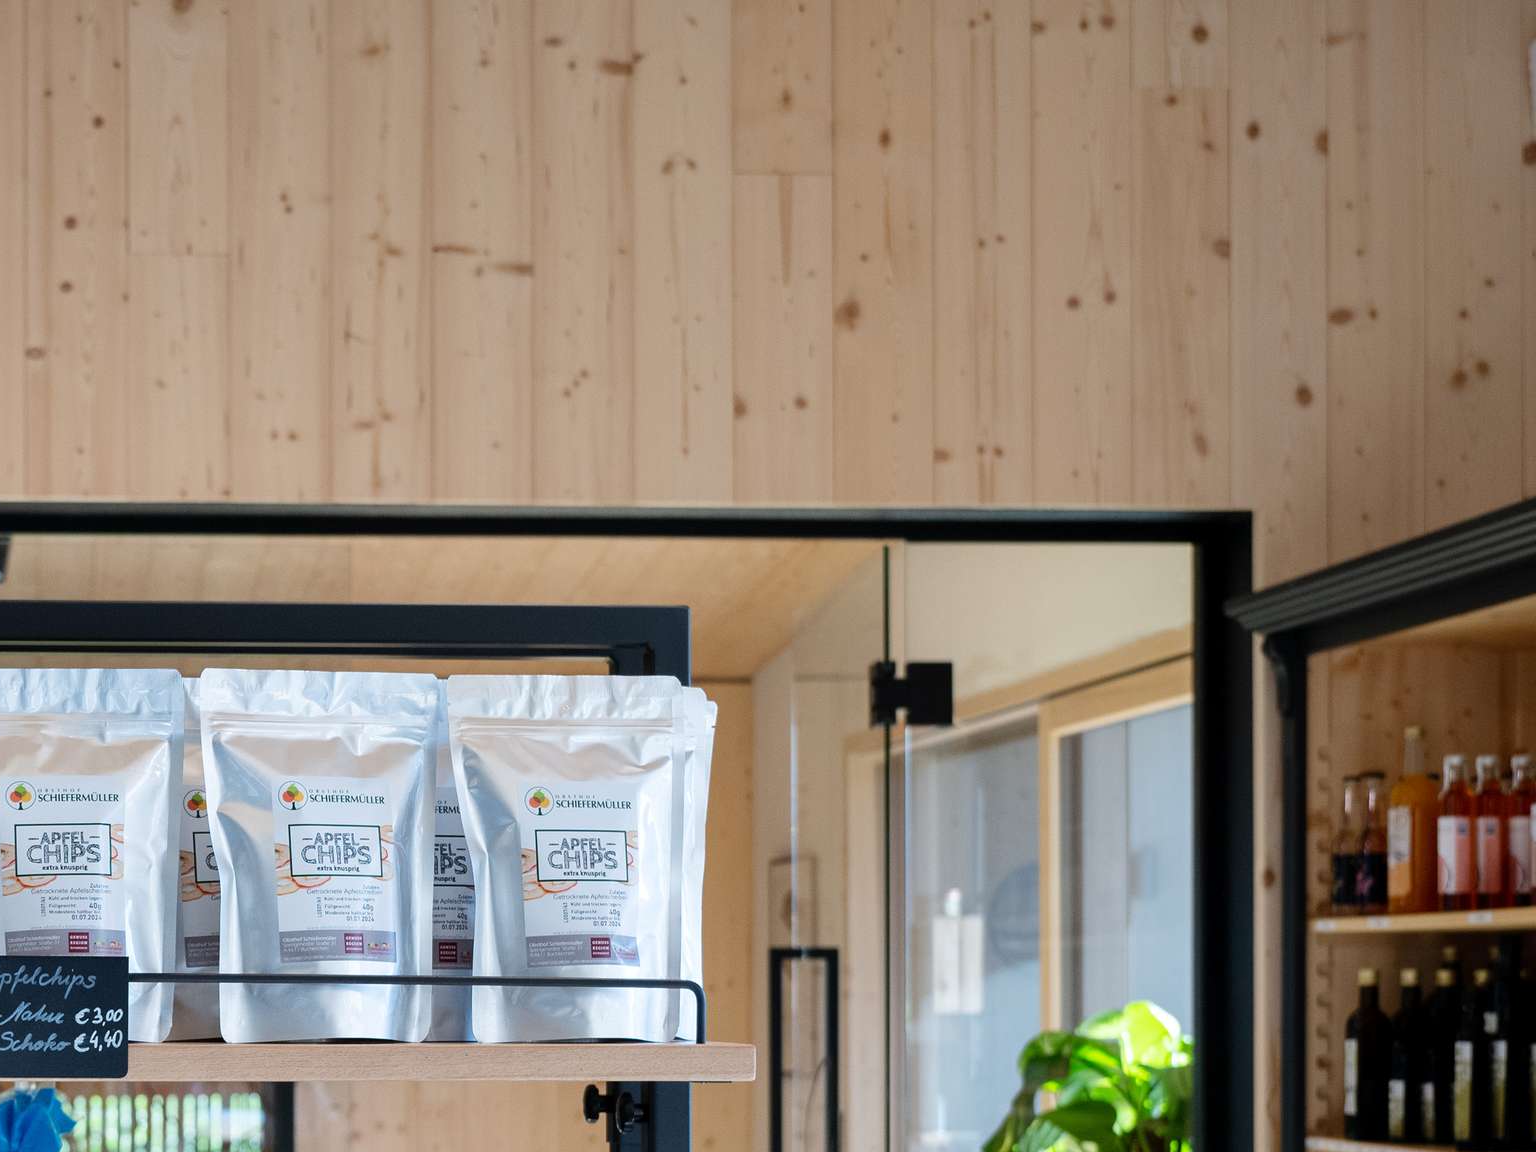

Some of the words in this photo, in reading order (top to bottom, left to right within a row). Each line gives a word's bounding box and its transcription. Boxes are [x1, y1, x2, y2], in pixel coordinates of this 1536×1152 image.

[38, 792, 119, 801] SCHIEFERMÜLLER
[310, 794, 384, 804] SCHIEFERMÜLLER
[556, 798, 631, 809] SCHIEFERMÜLLER
[40, 832, 88, 844] APFEL
[314, 832, 359, 845] APFEL
[560, 838, 606, 850] APFEL
[27, 844, 101, 863] CHIPS
[301, 845, 371, 865] CHIPS
[548, 851, 618, 869] CHIPS
